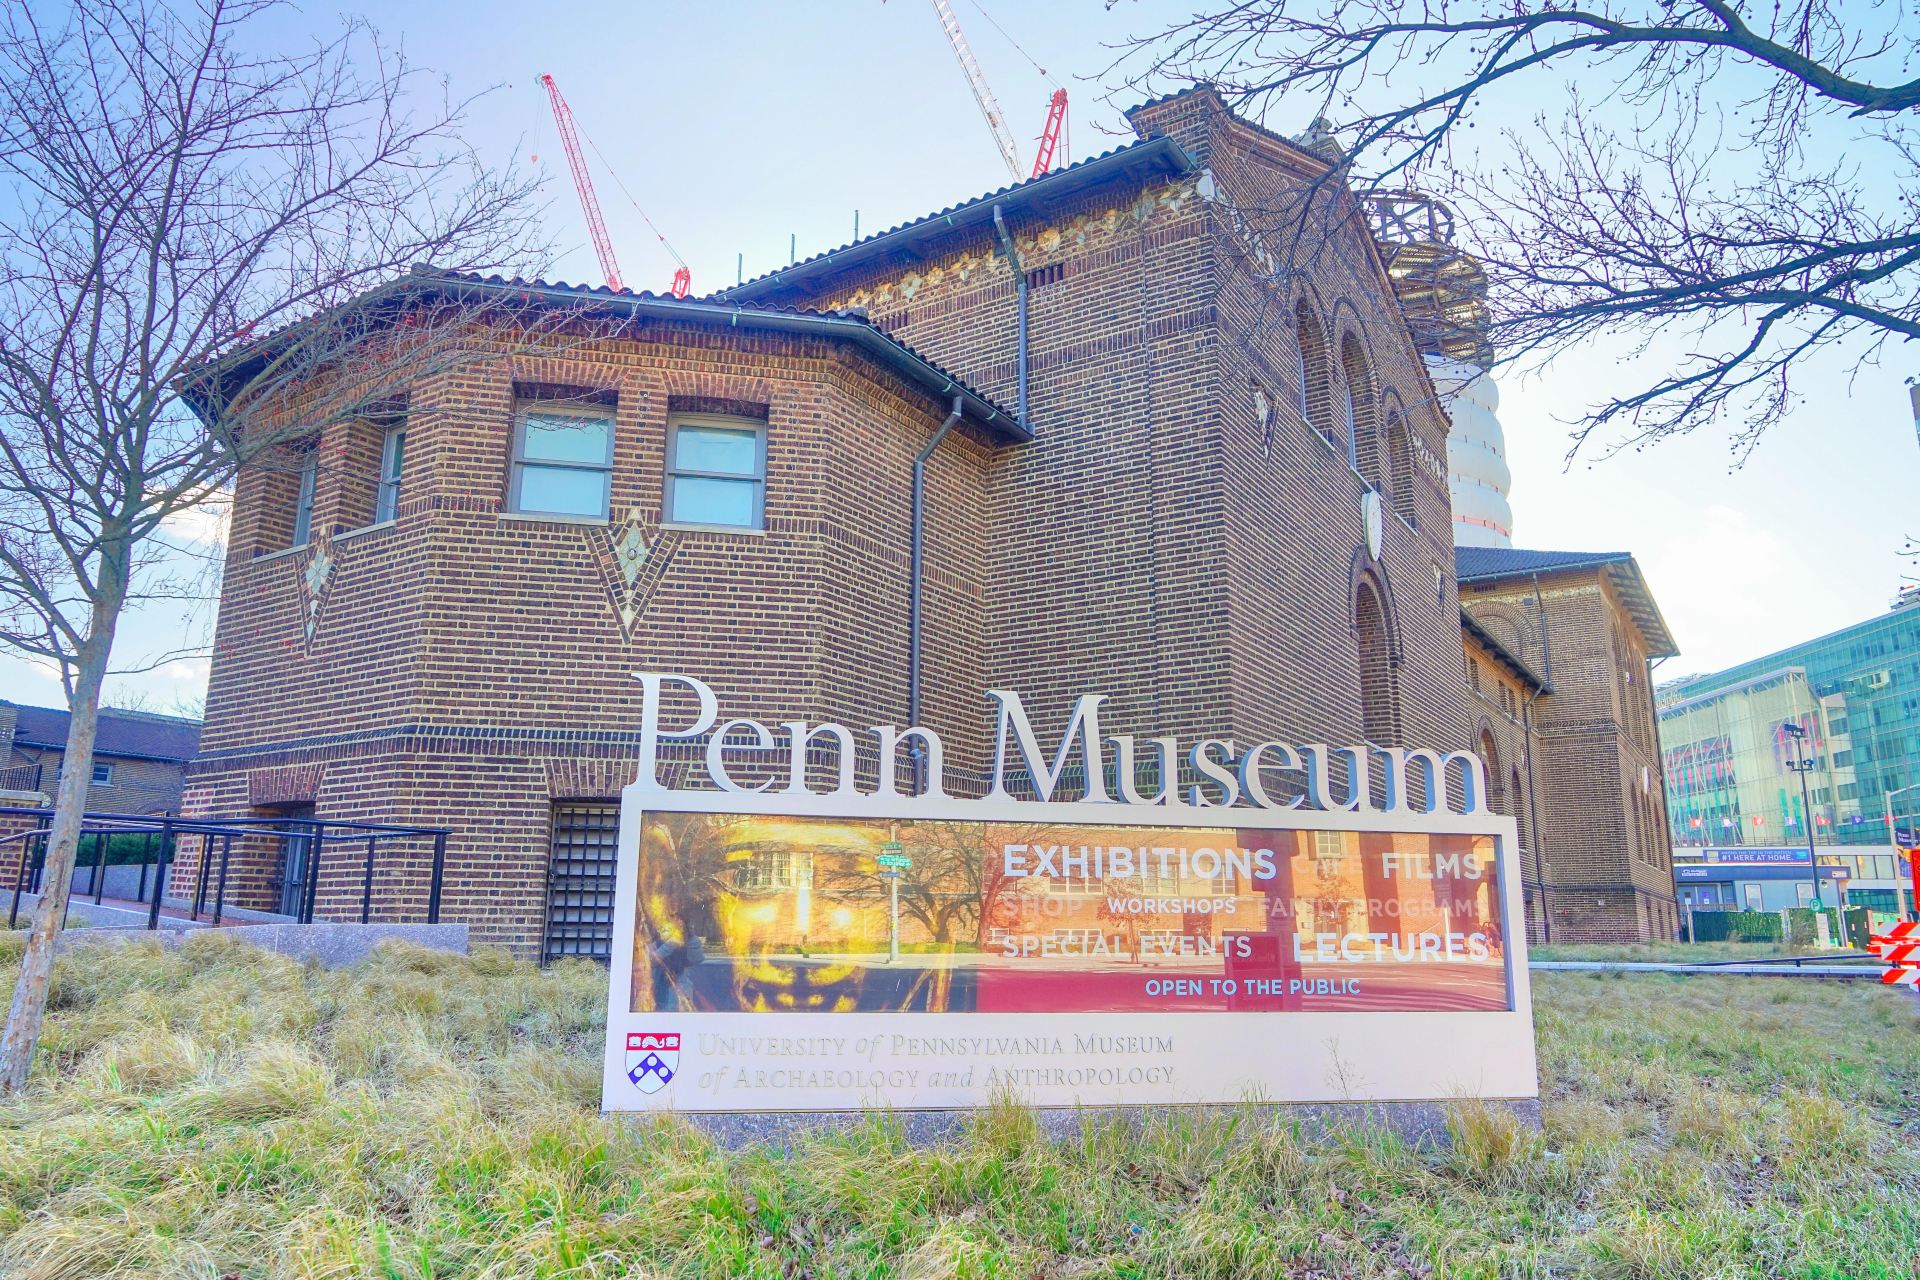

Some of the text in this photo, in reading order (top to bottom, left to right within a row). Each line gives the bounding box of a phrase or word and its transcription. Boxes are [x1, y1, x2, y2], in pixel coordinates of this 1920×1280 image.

[623, 672, 1496, 815] Penn Museum
[1004, 844, 1277, 880] EXHIBITIONS
[1382, 852, 1482, 880] FILMS
[1003, 897, 1083, 917] SHOP
[1107, 898, 1236, 914] WORKSHOPS
[1353, 898, 1488, 918] ROGRAMS
[1003, 934, 1252, 958] SPECIAL EVENTS
[1293, 932, 1489, 963] LECTURES
[1145, 978, 1361, 996] OPEN TO THE PUBLIC
[698, 1033, 1173, 1063] UNIVERSITY of PENNSYLVANIA MUSEUM
[699, 1064, 1174, 1095] of ARCHAEOLOGY and ANTHROPOLOGY
